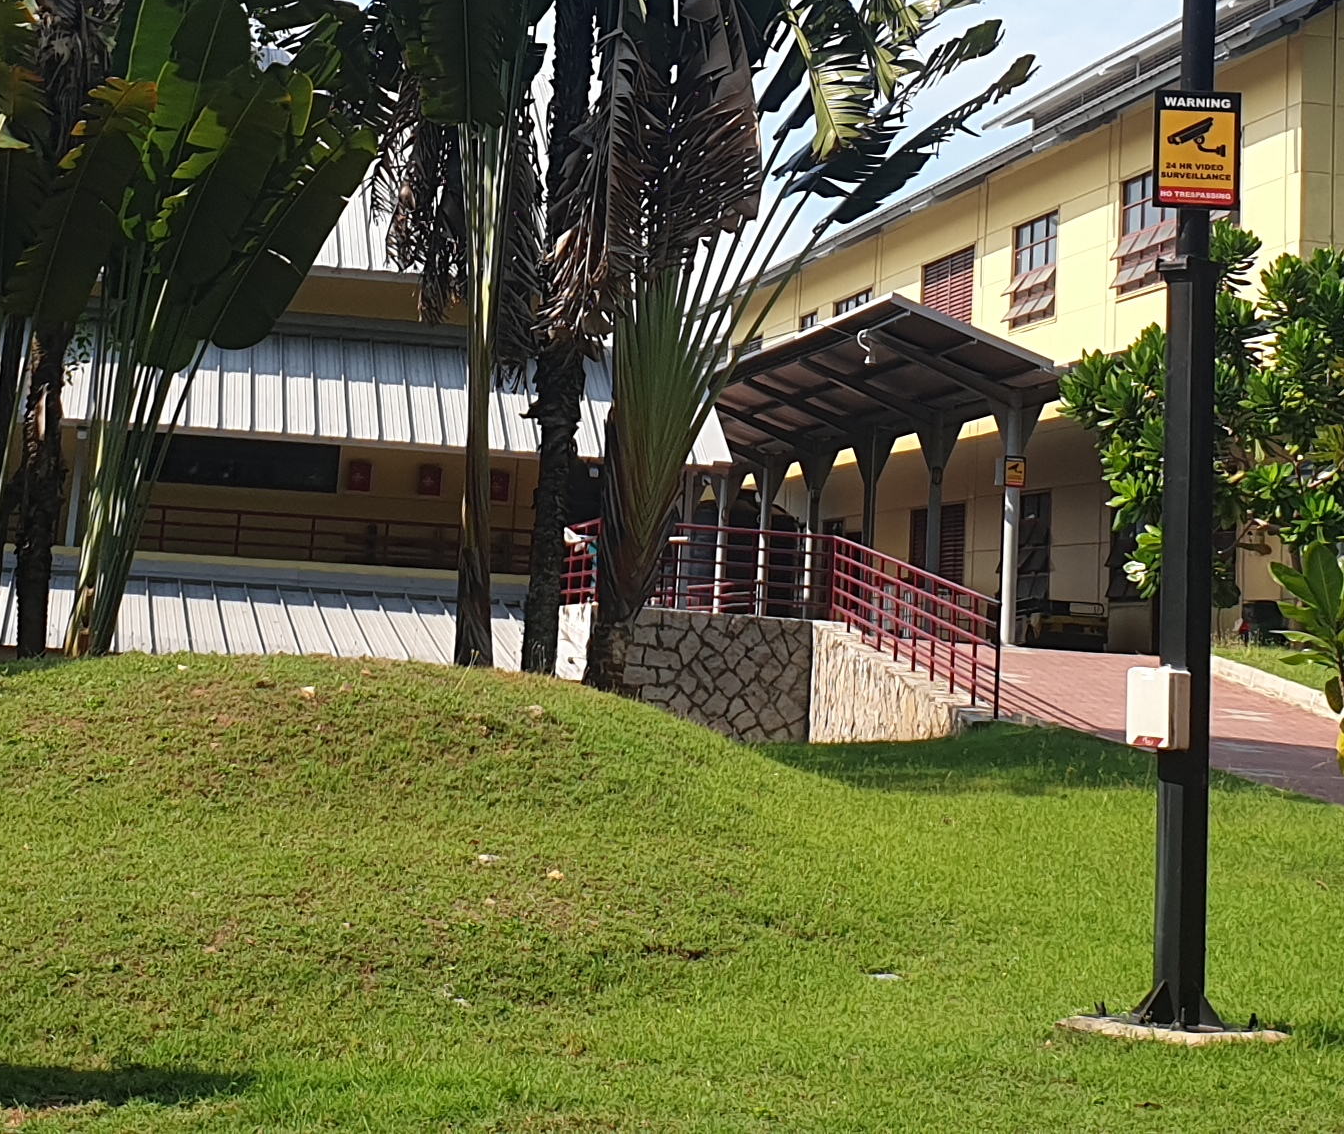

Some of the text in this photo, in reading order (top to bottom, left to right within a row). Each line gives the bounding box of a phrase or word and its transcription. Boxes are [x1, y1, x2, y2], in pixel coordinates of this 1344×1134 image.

[1164, 97, 1231, 109] WARNING
[1160, 171, 1231, 181] SURVEILLANCE
[1174, 190, 1231, 200] TRESPASSING
